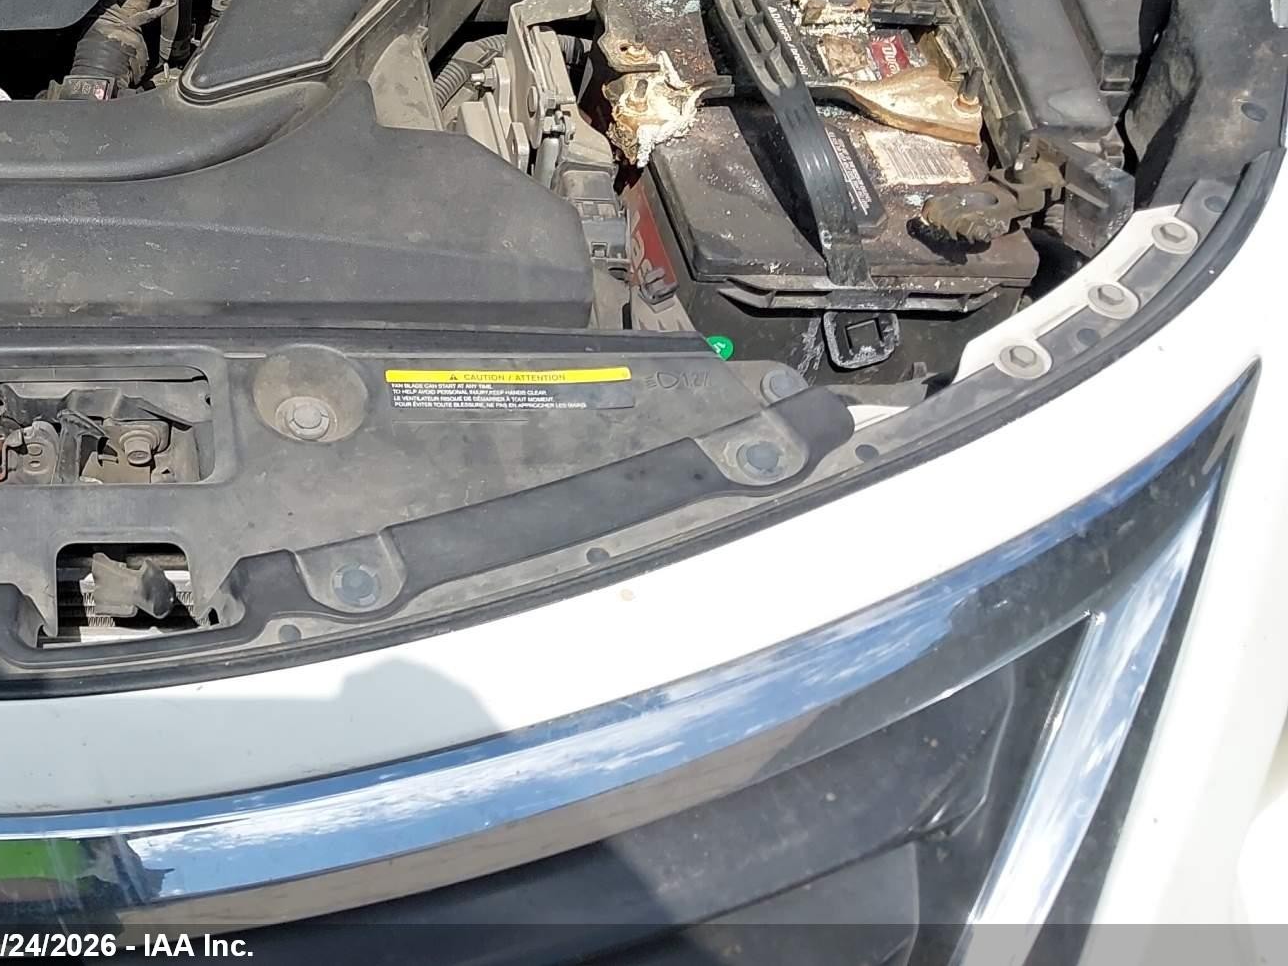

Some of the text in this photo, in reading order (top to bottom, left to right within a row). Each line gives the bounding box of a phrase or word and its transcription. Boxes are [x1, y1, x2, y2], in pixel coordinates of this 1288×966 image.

[771, 13, 792, 42] DANGER
[463, 373, 505, 381] CAUTION
[515, 373, 565, 382] ATTENTION
